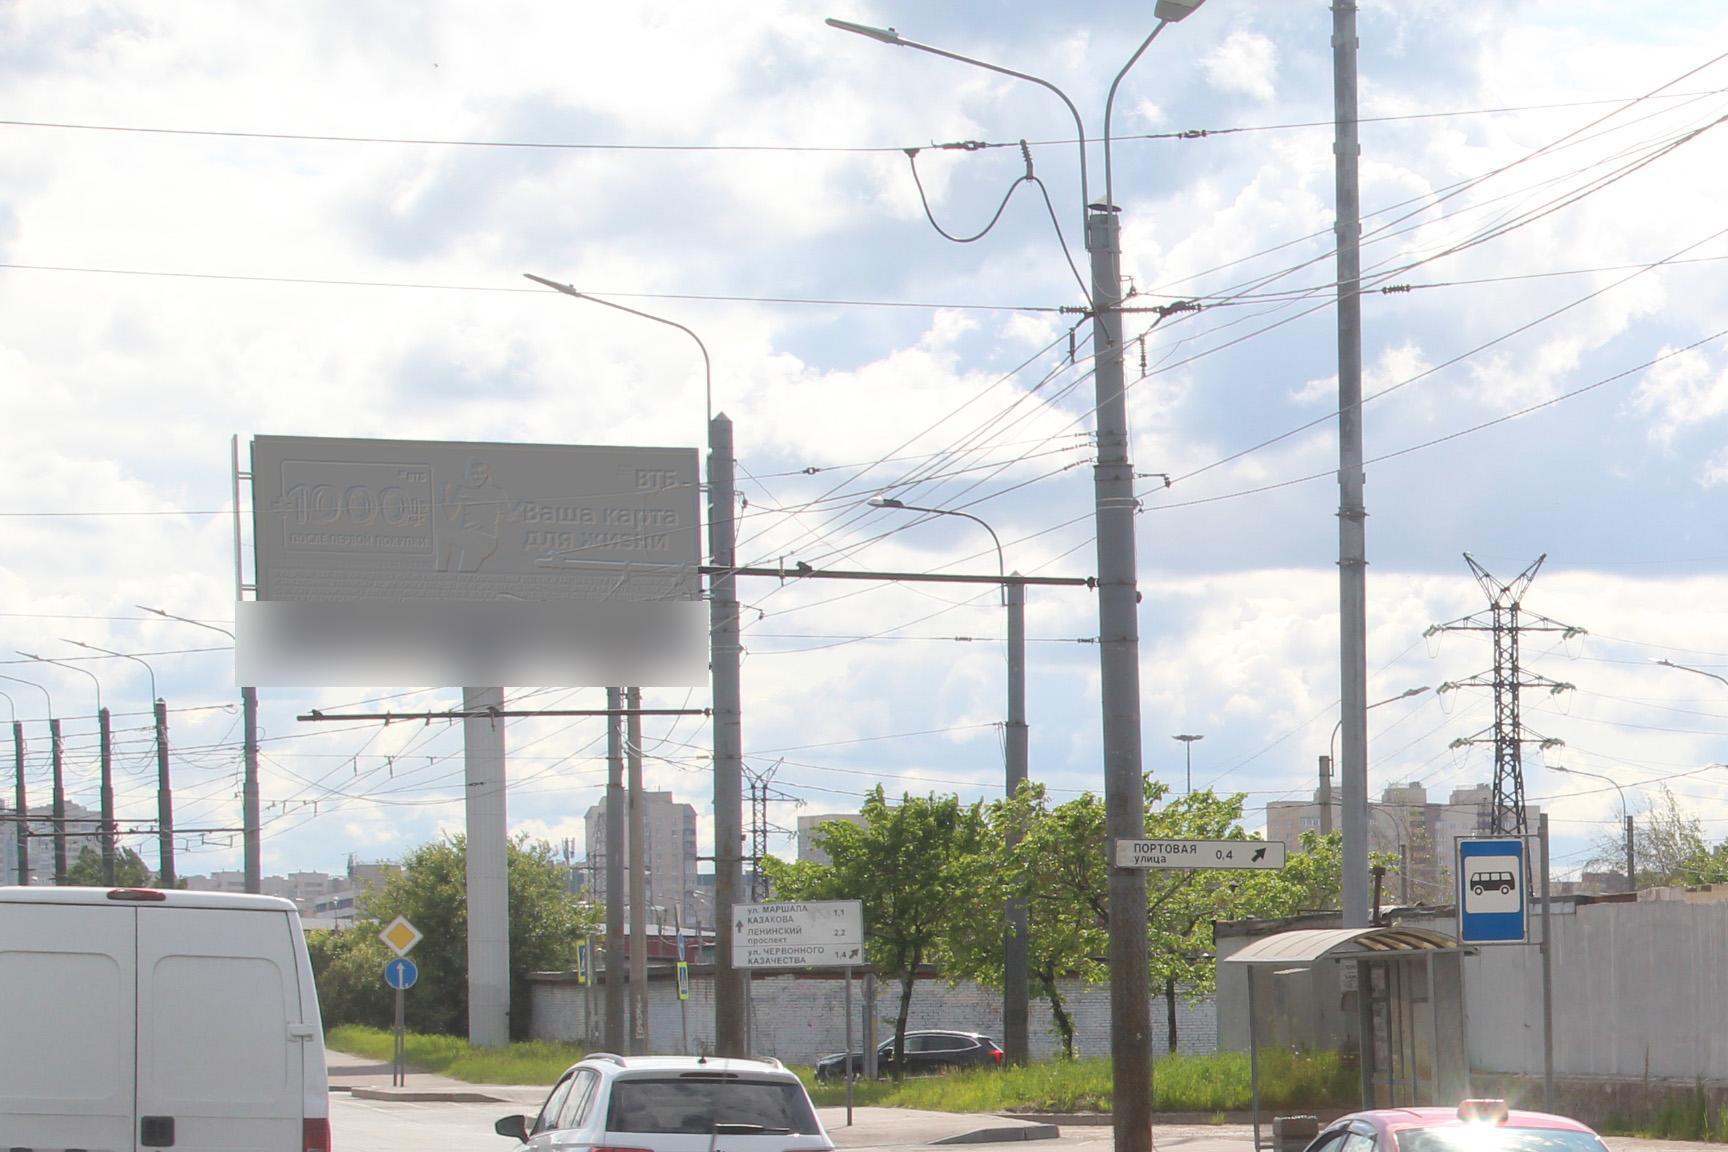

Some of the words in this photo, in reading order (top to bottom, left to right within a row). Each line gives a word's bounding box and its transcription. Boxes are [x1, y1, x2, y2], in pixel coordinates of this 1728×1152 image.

[1134, 843, 1197, 854] ПОРТОВАЯ
[1134, 856, 1167, 864] улица
[747, 926, 802, 936] ЛЕНИНСКИЙ
[763, 946, 825, 955] ЧЕРВОННОГО
[747, 957, 807, 965] КАЗАЧЕСТВА
